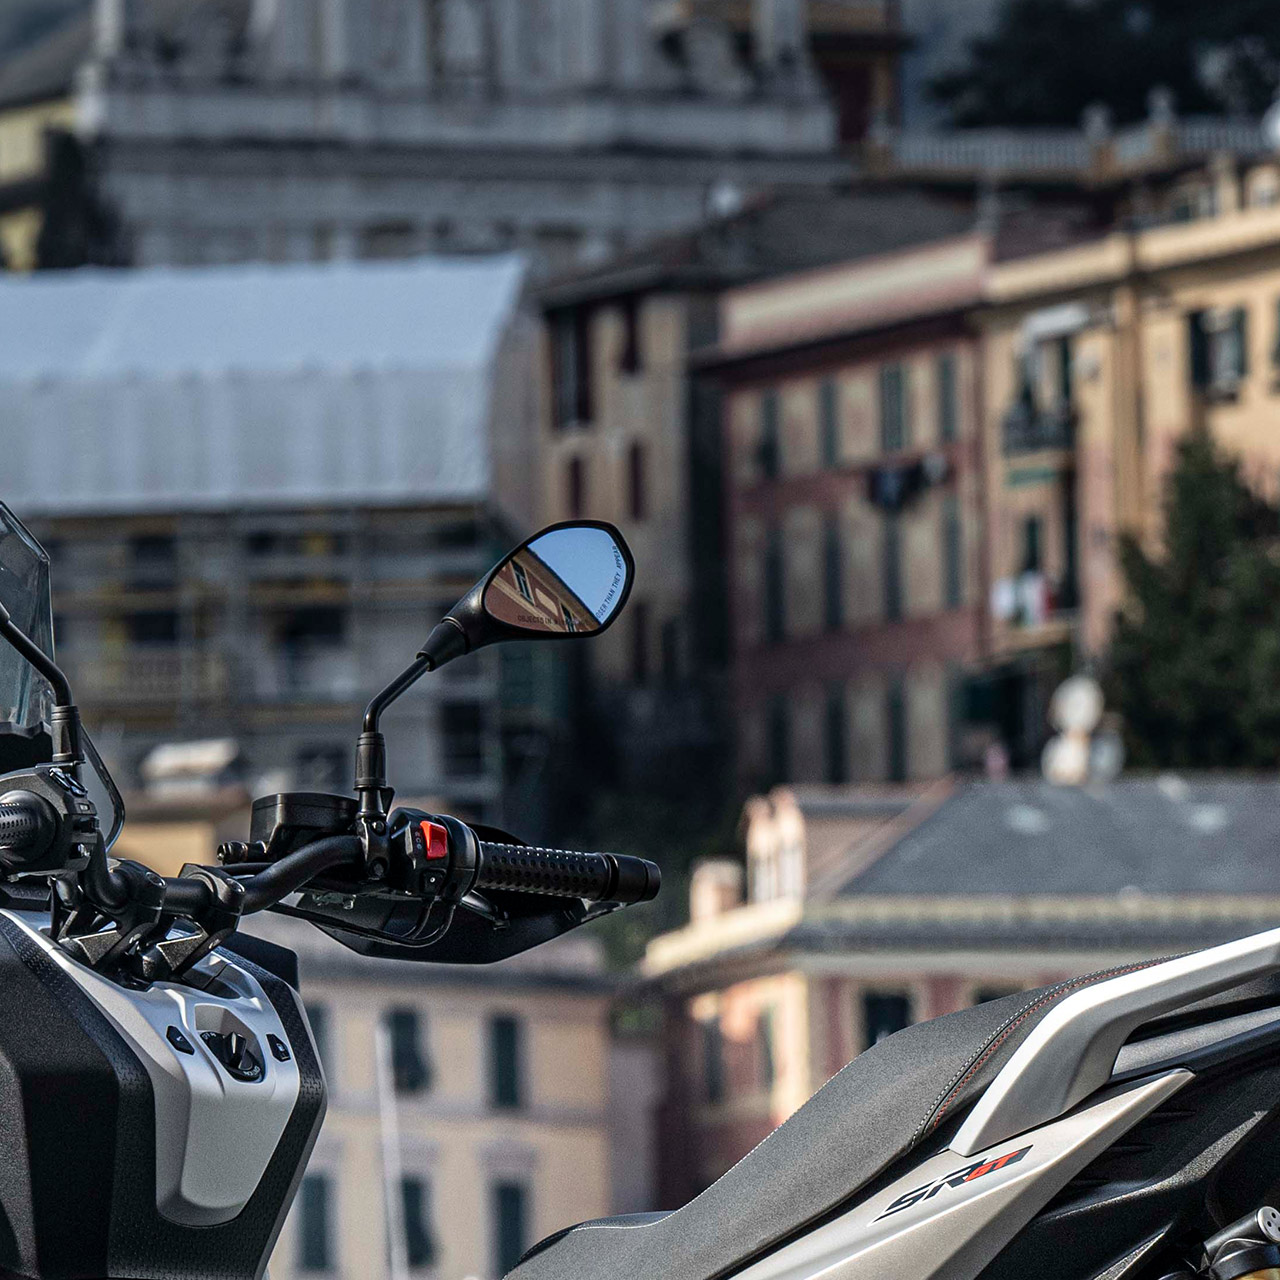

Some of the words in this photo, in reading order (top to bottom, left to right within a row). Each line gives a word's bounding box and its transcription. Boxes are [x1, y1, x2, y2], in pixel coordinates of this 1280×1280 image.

[605, 588, 616, 605] THAN
[611, 572, 622, 588] THEY
[964, 1150, 1020, 1183] GT
